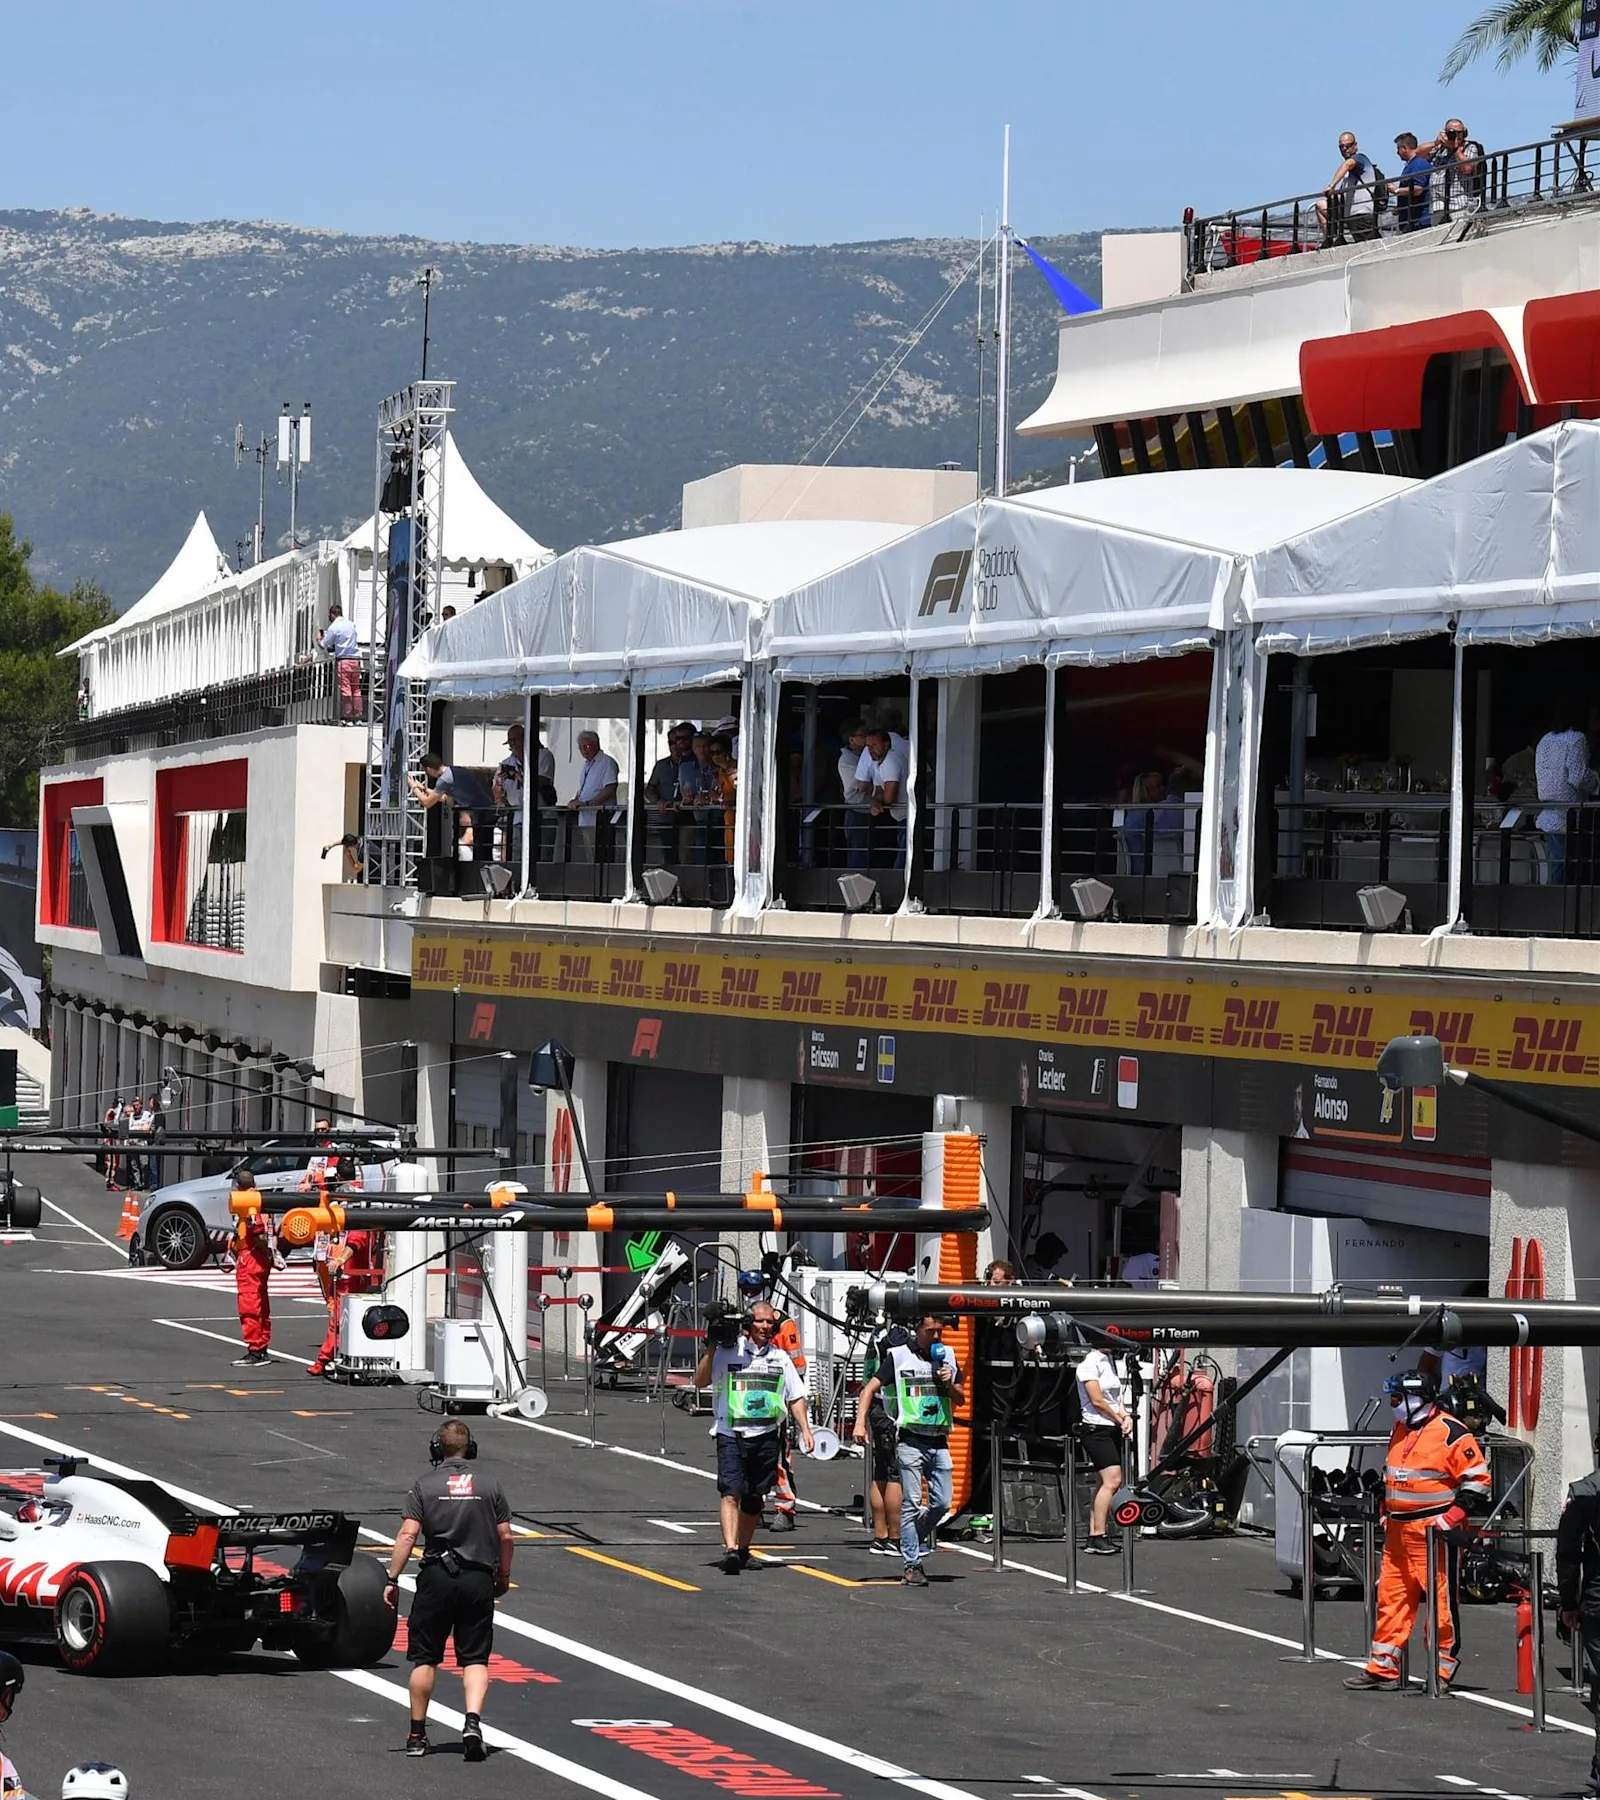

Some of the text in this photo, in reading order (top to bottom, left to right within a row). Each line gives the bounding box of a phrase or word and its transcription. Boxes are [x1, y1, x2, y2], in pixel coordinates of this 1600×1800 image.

[980, 546, 1019, 578] Paddock
[978, 581, 998, 611] Club
[418, 948, 449, 982] DHL
[463, 950, 494, 985] DHL
[510, 952, 543, 988] DHL
[558, 955, 593, 992] DHL
[610, 958, 646, 998] DHL
[664, 963, 703, 1003] DHL
[721, 967, 761, 1008] DHL
[782, 971, 824, 1013] DHL
[845, 975, 889, 1018] DHL
[912, 978, 960, 1022] DHL
[982, 982, 1032, 1028] DHL
[1057, 987, 1111, 1034] DHL
[1136, 992, 1195, 1041] DHL
[1223, 999, 1284, 1050] DHL
[1311, 1004, 1376, 1059] DHL
[1511, 1017, 1585, 1074] DHL
[811, 1038, 867, 1071] Ericsson 9
[1037, 1066, 1066, 1091] Leclerc
[1314, 1073, 1338, 1090] Fernando
[1313, 1092, 1349, 1122] Alonso
[408, 1217, 513, 1228] McLaren
[1344, 1239, 1405, 1248] FERNANDO
[967, 1297, 1050, 1309] Haas F1 Team
[1122, 1328, 1200, 1339] Haas F1 Team
[84, 1513, 141, 1530] HaasCNC.com
[589, 1726, 844, 1798] GROSJEAN
